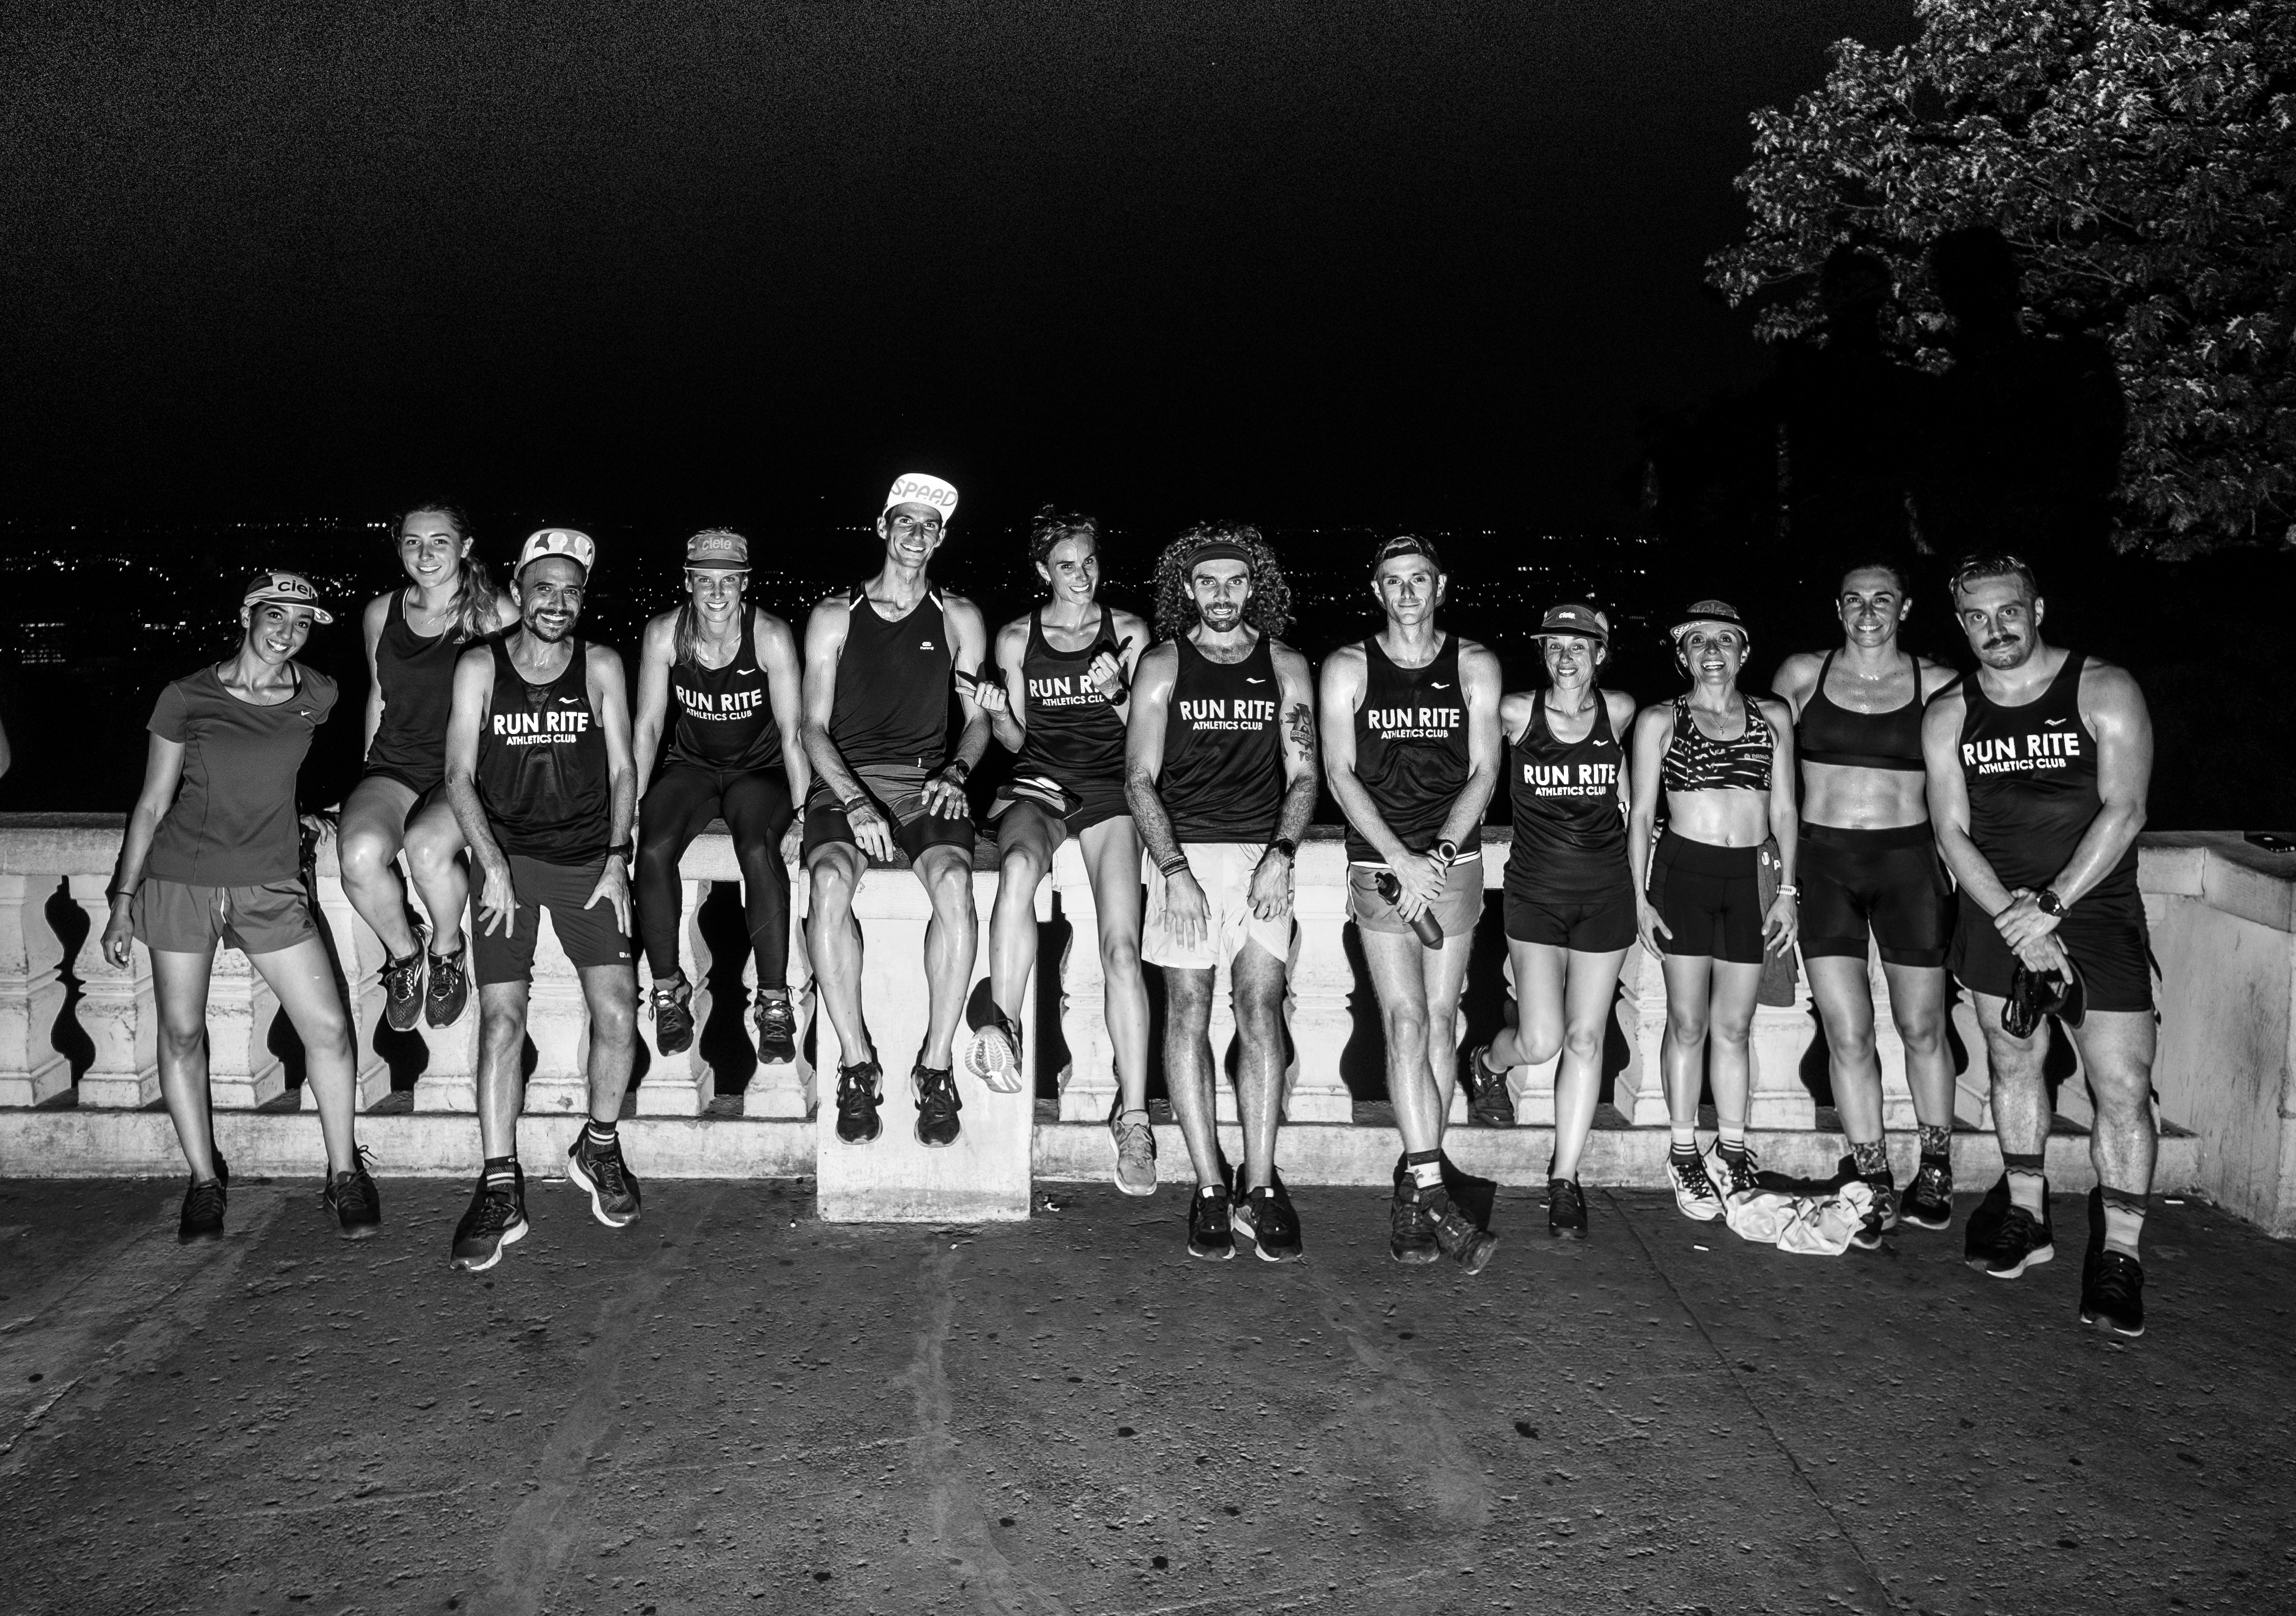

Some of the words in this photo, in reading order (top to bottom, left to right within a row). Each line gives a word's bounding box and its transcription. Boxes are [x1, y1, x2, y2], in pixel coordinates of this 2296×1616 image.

[702, 538, 732, 550] ciele
[1029, 676, 1071, 697] RUN
[676, 685, 713, 712] RUN
[721, 688, 762, 711] RITE
[1042, 695, 1086, 706] ATHLETICS
[1088, 694, 1105, 703] CLU
[686, 707, 727, 721] ATHLETICS
[729, 710, 752, 720] CLUB
[1179, 699, 1225, 720] RUN
[1234, 700, 1275, 721] RITE
[1368, 707, 1412, 729] RUN
[1419, 707, 1460, 728] RITE
[494, 712, 539, 735] RUN
[546, 711, 589, 732] RITE
[1192, 721, 1238, 730] ATHLETICS
[1240, 721, 1263, 730] CLUB
[506, 734, 552, 746] ATHLETICS
[553, 733, 577, 743] CLUB
[1381, 729, 1424, 740] ATHLETICS
[1425, 729, 1448, 738] CLUB
[1962, 736, 2016, 766] RUN
[2027, 732, 2080, 757] RITE
[1524, 764, 1569, 786] RUN
[1578, 764, 1615, 784] RITE
[1979, 759, 2034, 775] ATHLETICS
[2036, 758, 2066, 769] CLUB
[1535, 786, 1584, 797] ATHLETICS
[1586, 786, 1606, 796] CLUB
